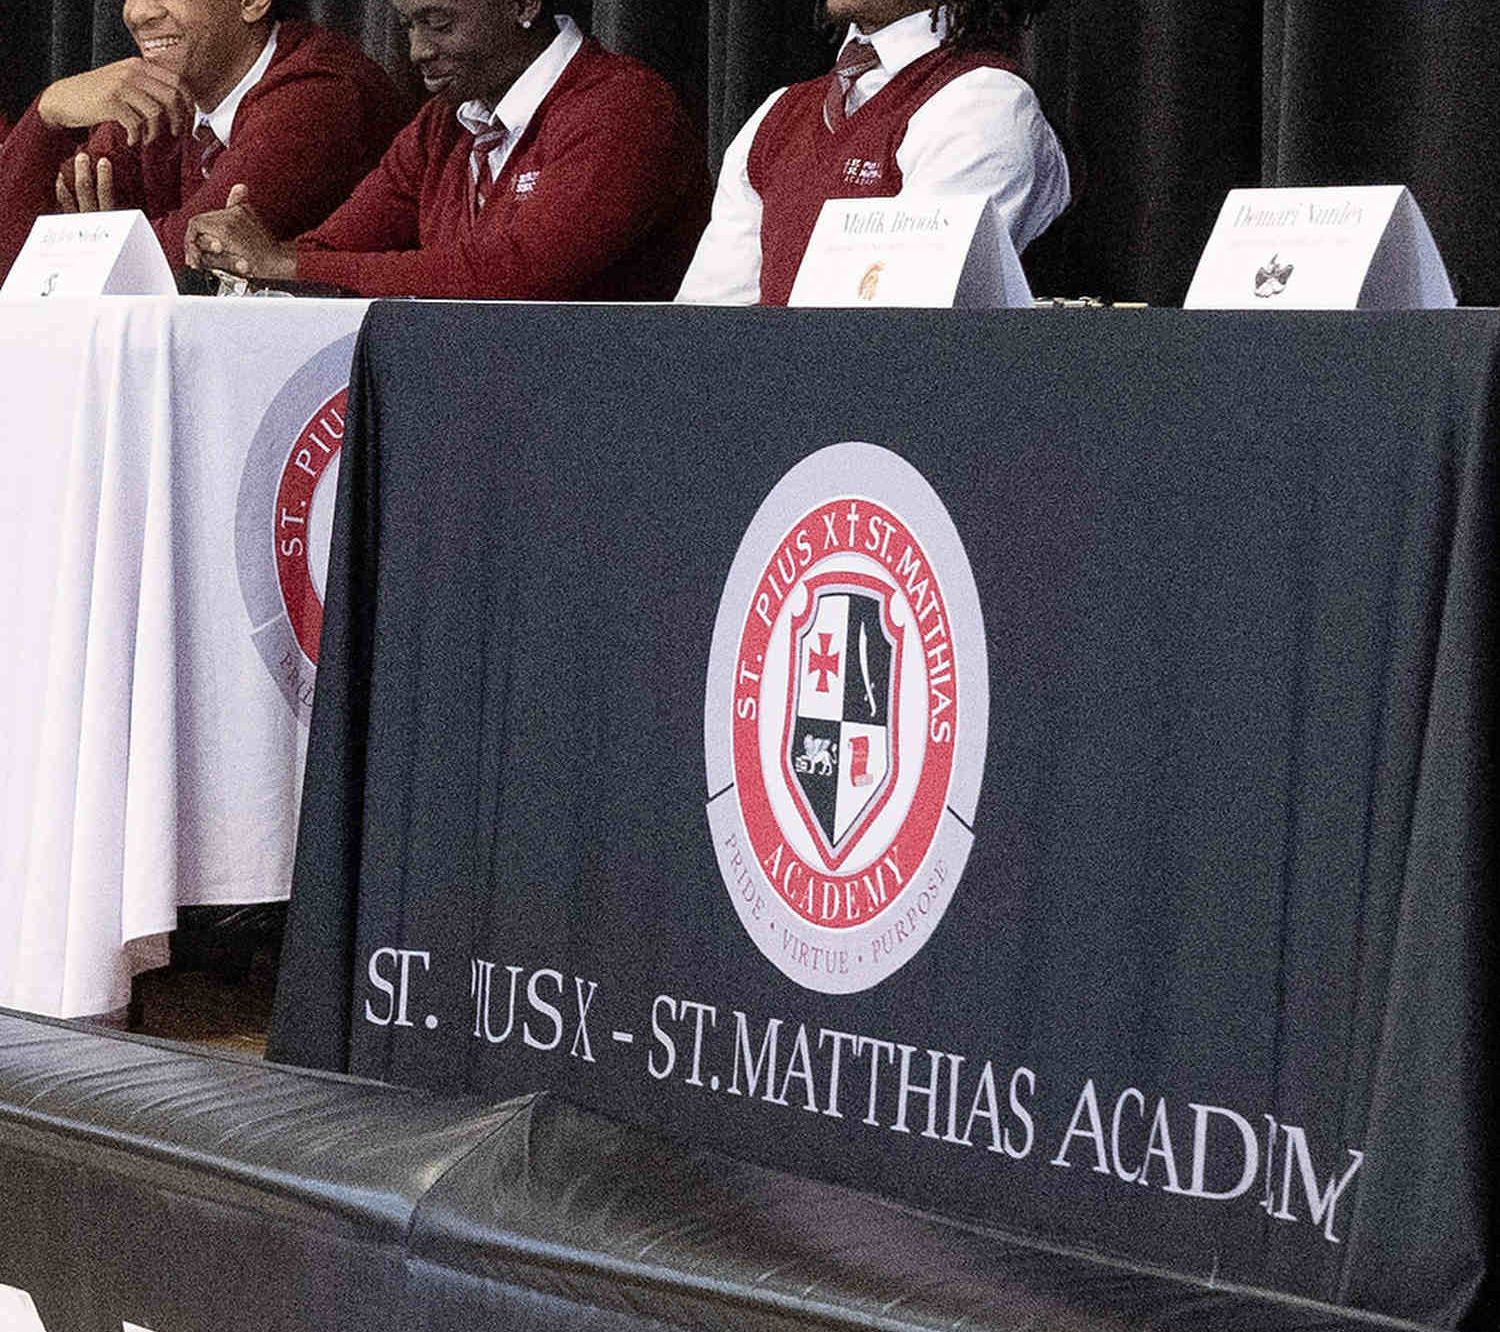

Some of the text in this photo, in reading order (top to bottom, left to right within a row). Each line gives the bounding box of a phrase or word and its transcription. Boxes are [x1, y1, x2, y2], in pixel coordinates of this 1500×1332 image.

[280, 407, 346, 559] ST. PIU
[279, 649, 315, 710] PRI
[735, 512, 955, 745] ST. PIUS X ST. MATTHIAS
[724, 832, 949, 976] PRIDE VIRTUE PURPOSE
[764, 844, 908, 924] ACADEMY
[364, 946, 439, 1030] ST.
[470, 958, 565, 1051] IUS
[570, 976, 599, 1064] X
